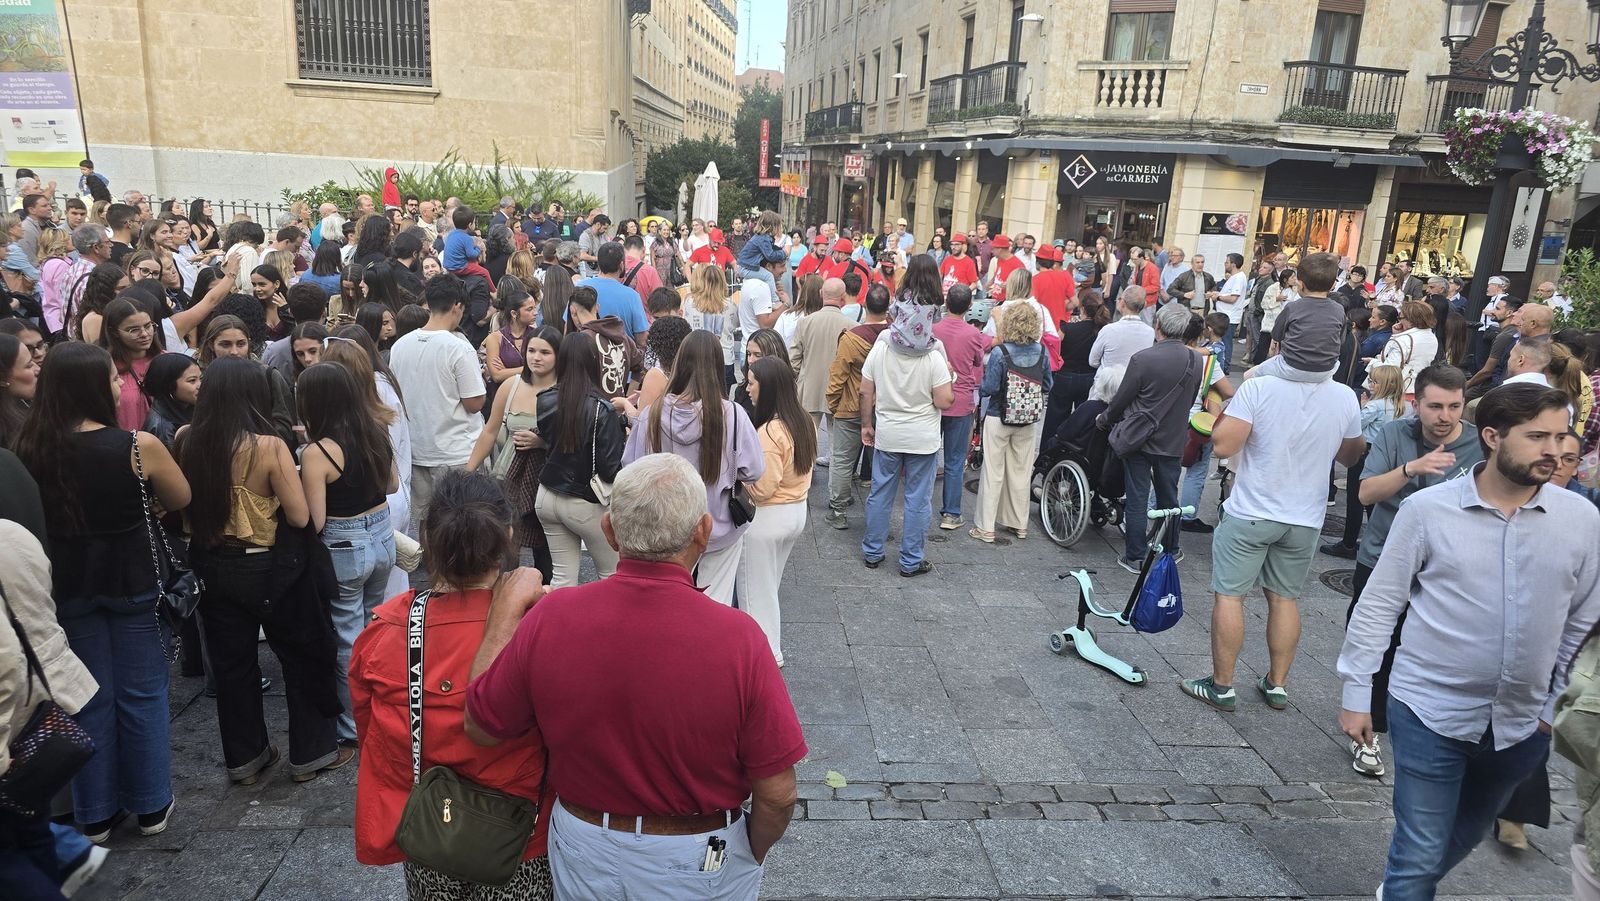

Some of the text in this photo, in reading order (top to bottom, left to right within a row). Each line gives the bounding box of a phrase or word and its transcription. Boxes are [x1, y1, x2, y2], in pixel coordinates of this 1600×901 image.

[1105, 163, 1168, 174] JAMONERÍA
[1114, 173, 1160, 184] CARMEN
[410, 594, 428, 649] BIMBA
